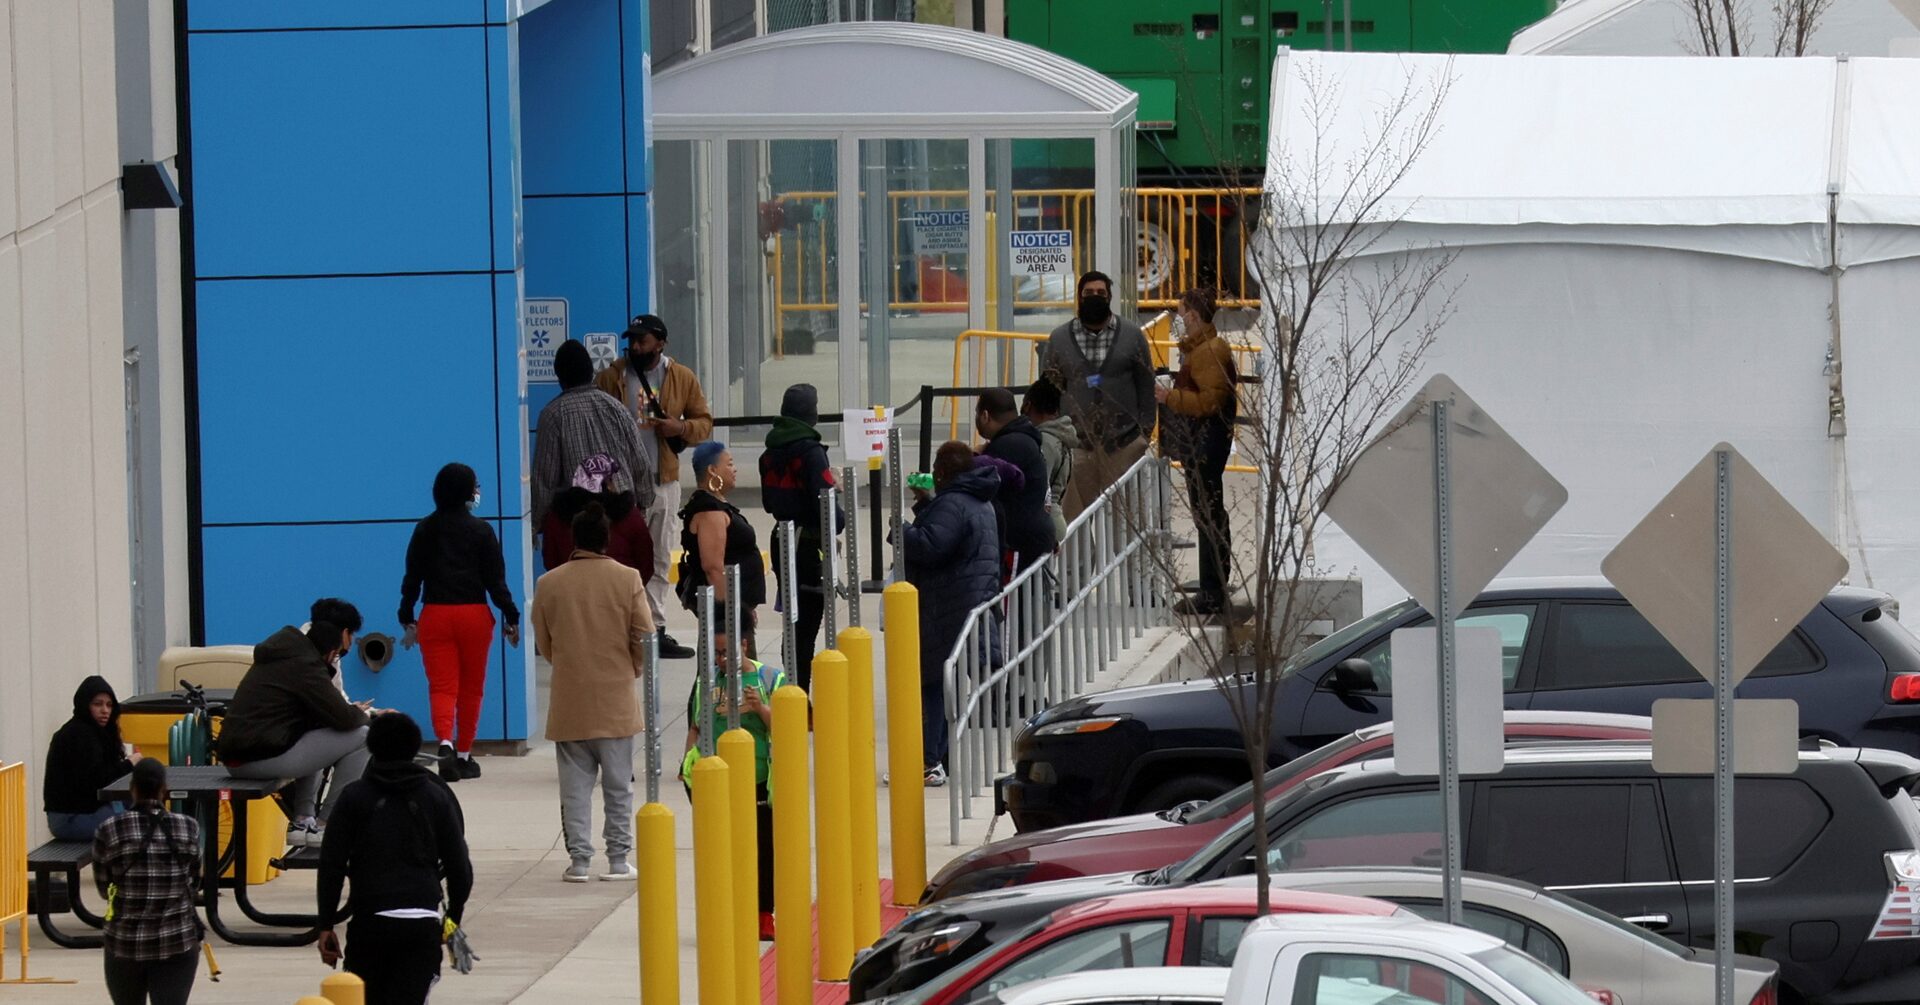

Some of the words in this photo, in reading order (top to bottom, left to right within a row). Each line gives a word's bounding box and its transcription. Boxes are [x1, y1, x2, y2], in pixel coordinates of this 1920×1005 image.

[917, 212, 969, 225] NOTICE
[1013, 233, 1068, 247] NOTICE
[1016, 254, 1066, 264] SMOKING
[1027, 264, 1056, 273] AREA
[530, 306, 549, 314] BLUE
[526, 318, 563, 327] FLECTORS
[527, 359, 554, 367] REEZIN
